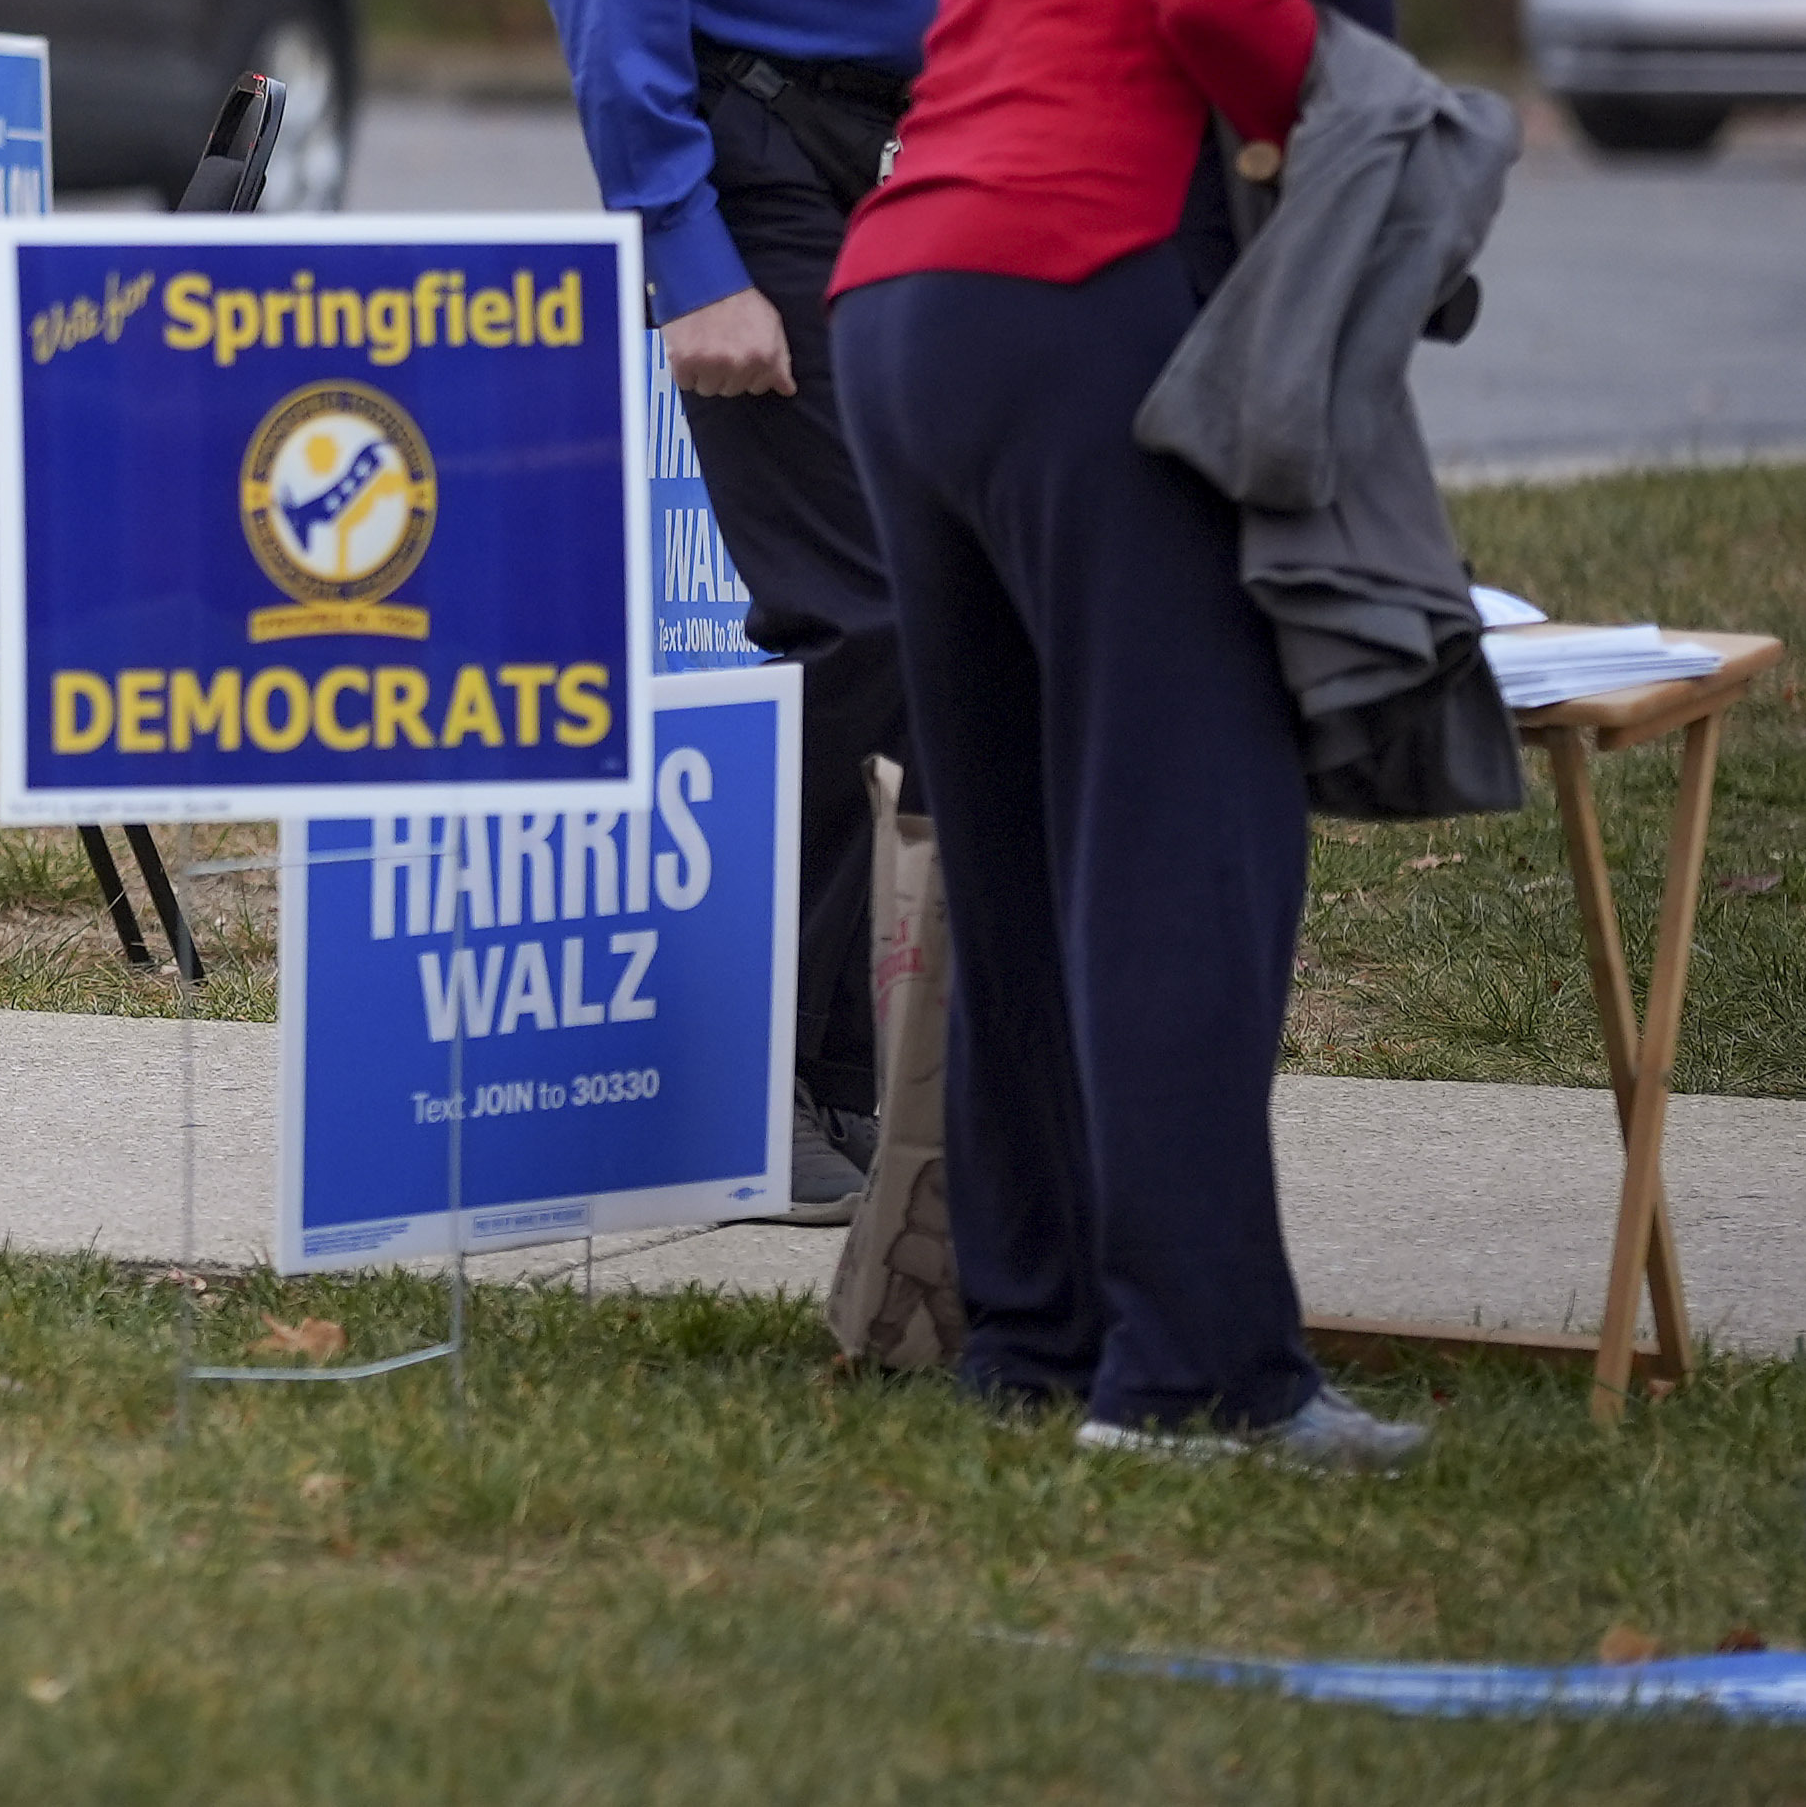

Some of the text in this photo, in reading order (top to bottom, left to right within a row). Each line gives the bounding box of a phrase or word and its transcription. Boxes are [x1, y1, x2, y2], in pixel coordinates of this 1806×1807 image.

[162, 268, 585, 367] Springfield
[664, 509, 753, 603] WAL
[658, 617, 683, 652] Text
[685, 617, 713, 652] JOIN
[714, 620, 726, 652] to
[51, 662, 613, 757] DEMOCRATS
[369, 746, 714, 940] HARRIS
[417, 929, 659, 1043] WALZ
[411, 1068, 661, 1125] Text JOIN to 30330
